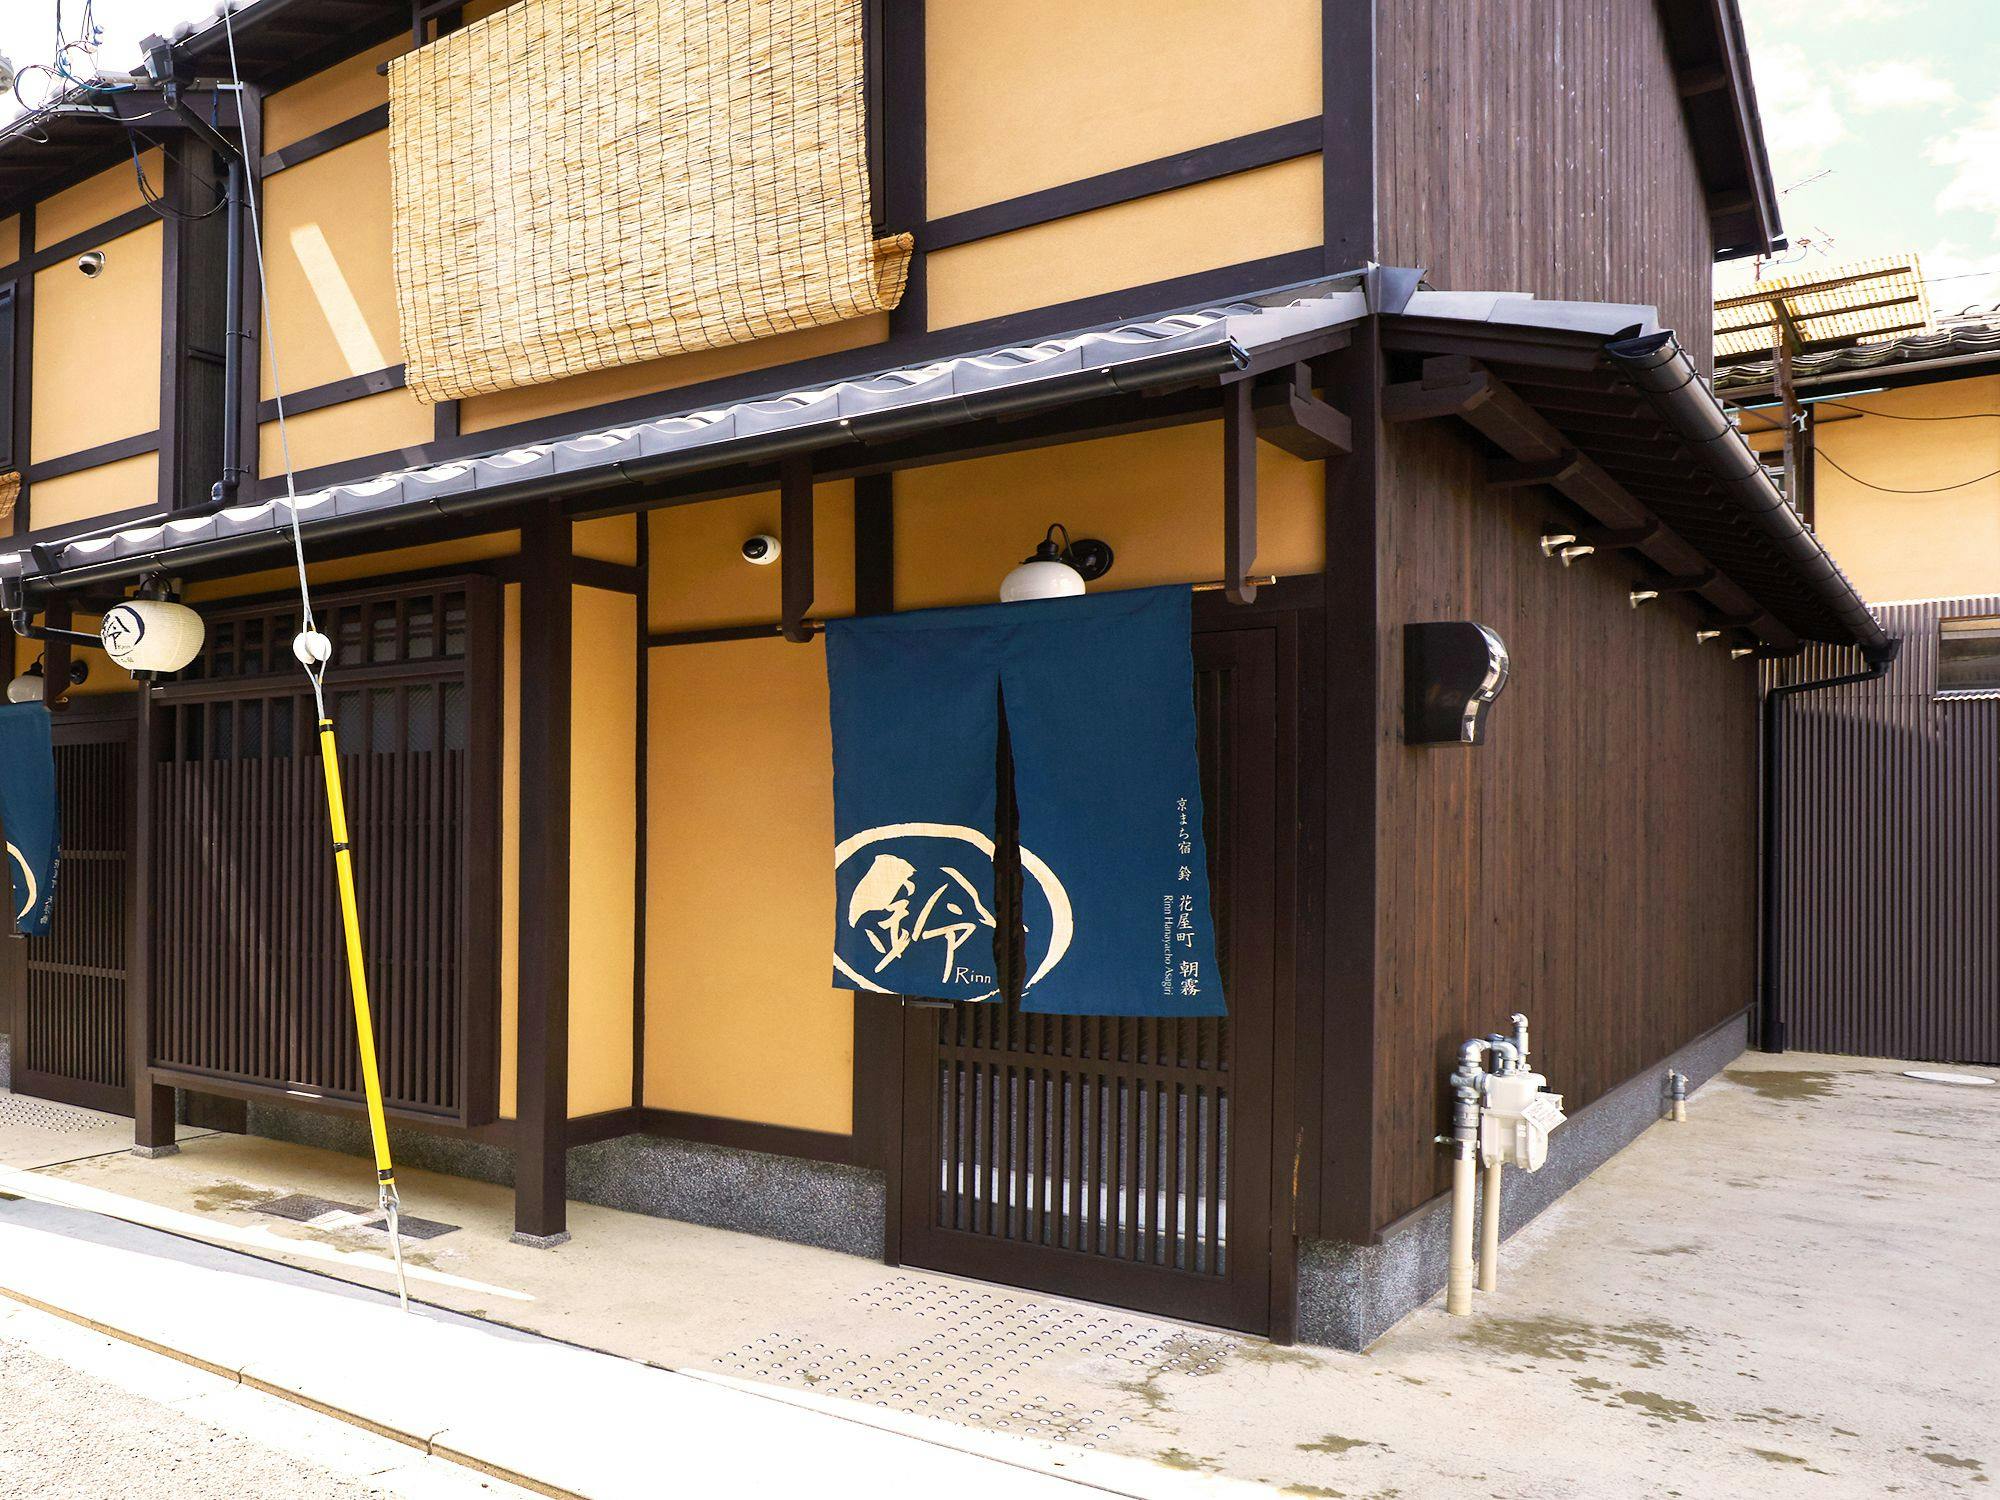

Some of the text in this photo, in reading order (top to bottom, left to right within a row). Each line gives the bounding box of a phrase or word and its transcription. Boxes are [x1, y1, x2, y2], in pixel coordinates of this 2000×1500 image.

[1177, 865, 1192, 881] 鈴
[848, 854, 997, 984] 鈴
[1176, 894, 1195, 948] 花屋町
[1161, 895, 1174, 996] Rinn Hanayacho Asagiri
[955, 966, 991, 984] Rinn
[1179, 960, 1201, 996] 朝霧
